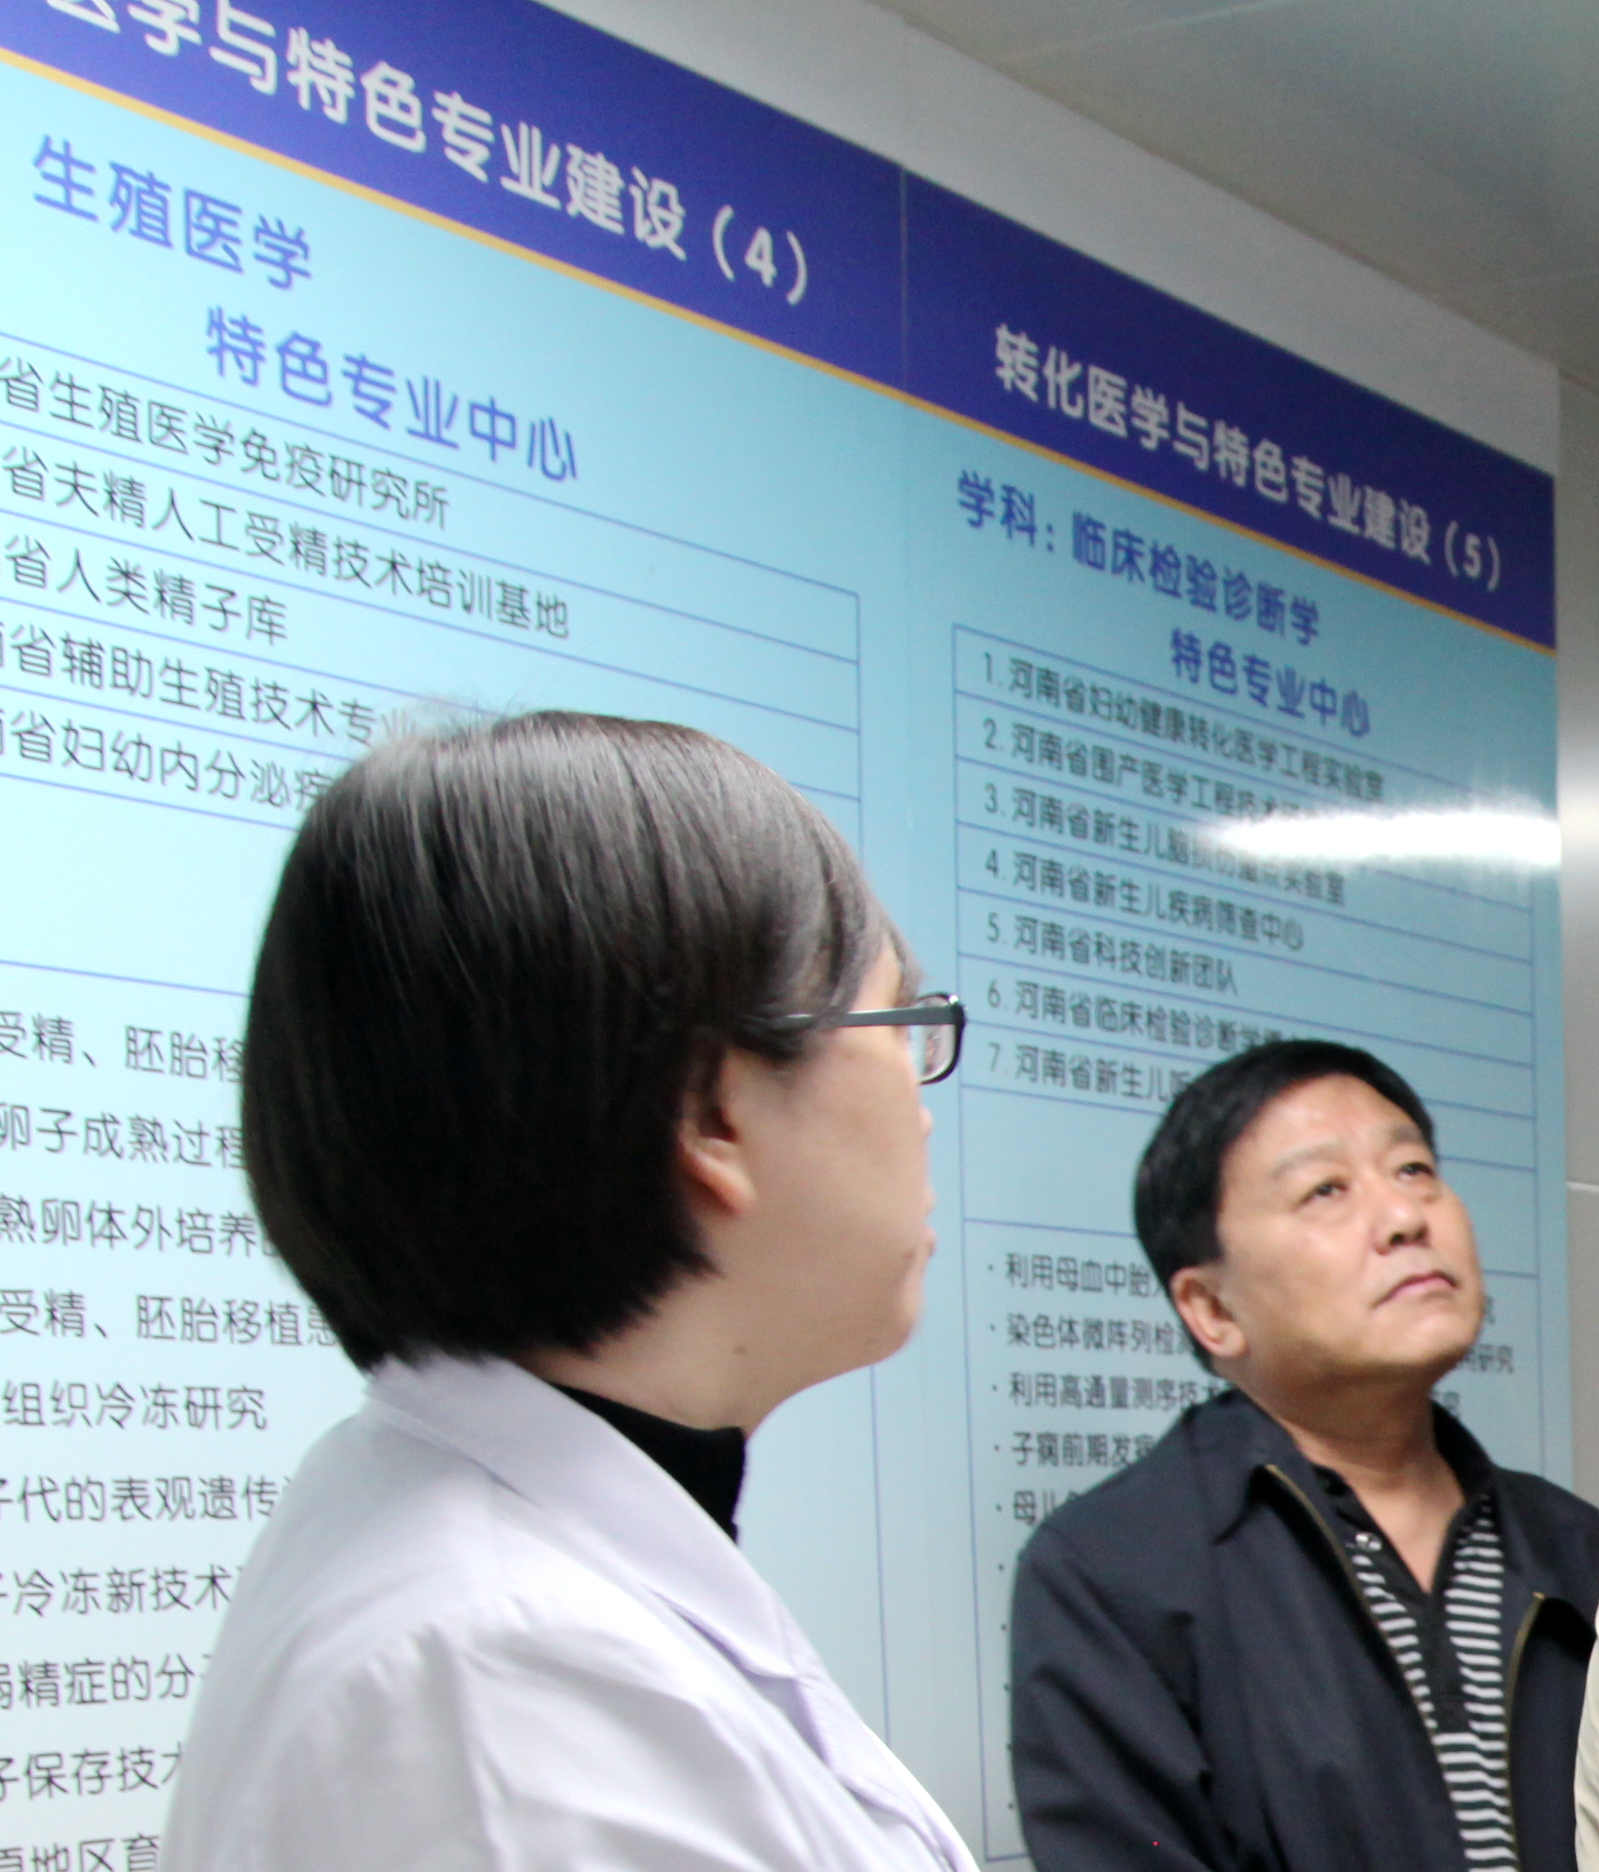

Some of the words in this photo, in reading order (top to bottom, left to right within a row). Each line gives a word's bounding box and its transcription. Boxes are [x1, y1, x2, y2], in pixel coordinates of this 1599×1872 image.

[32, 134, 313, 292] 生殖医学
[0, 356, 450, 532] 省生殖医学免疫研究所
[205, 305, 580, 484] 特色专业中心
[2, 444, 571, 641] 省夫精人工受精技术培训基地
[4, 534, 289, 646] 省人类精子库
[956, 468, 1321, 647] 学科：临床检验诊断学
[0, 620, 412, 748] 省辅助生殖技术专
[1170, 626, 1372, 738] 特色专业中心
[1014, 914, 1237, 996] 河南省科技创新团队
[0, 1194, 284, 1258] 熟卵体外培养
[3, 1379, 269, 1430] 组织冷冻研究
[0, 1474, 291, 1523] 代的表观遗传
